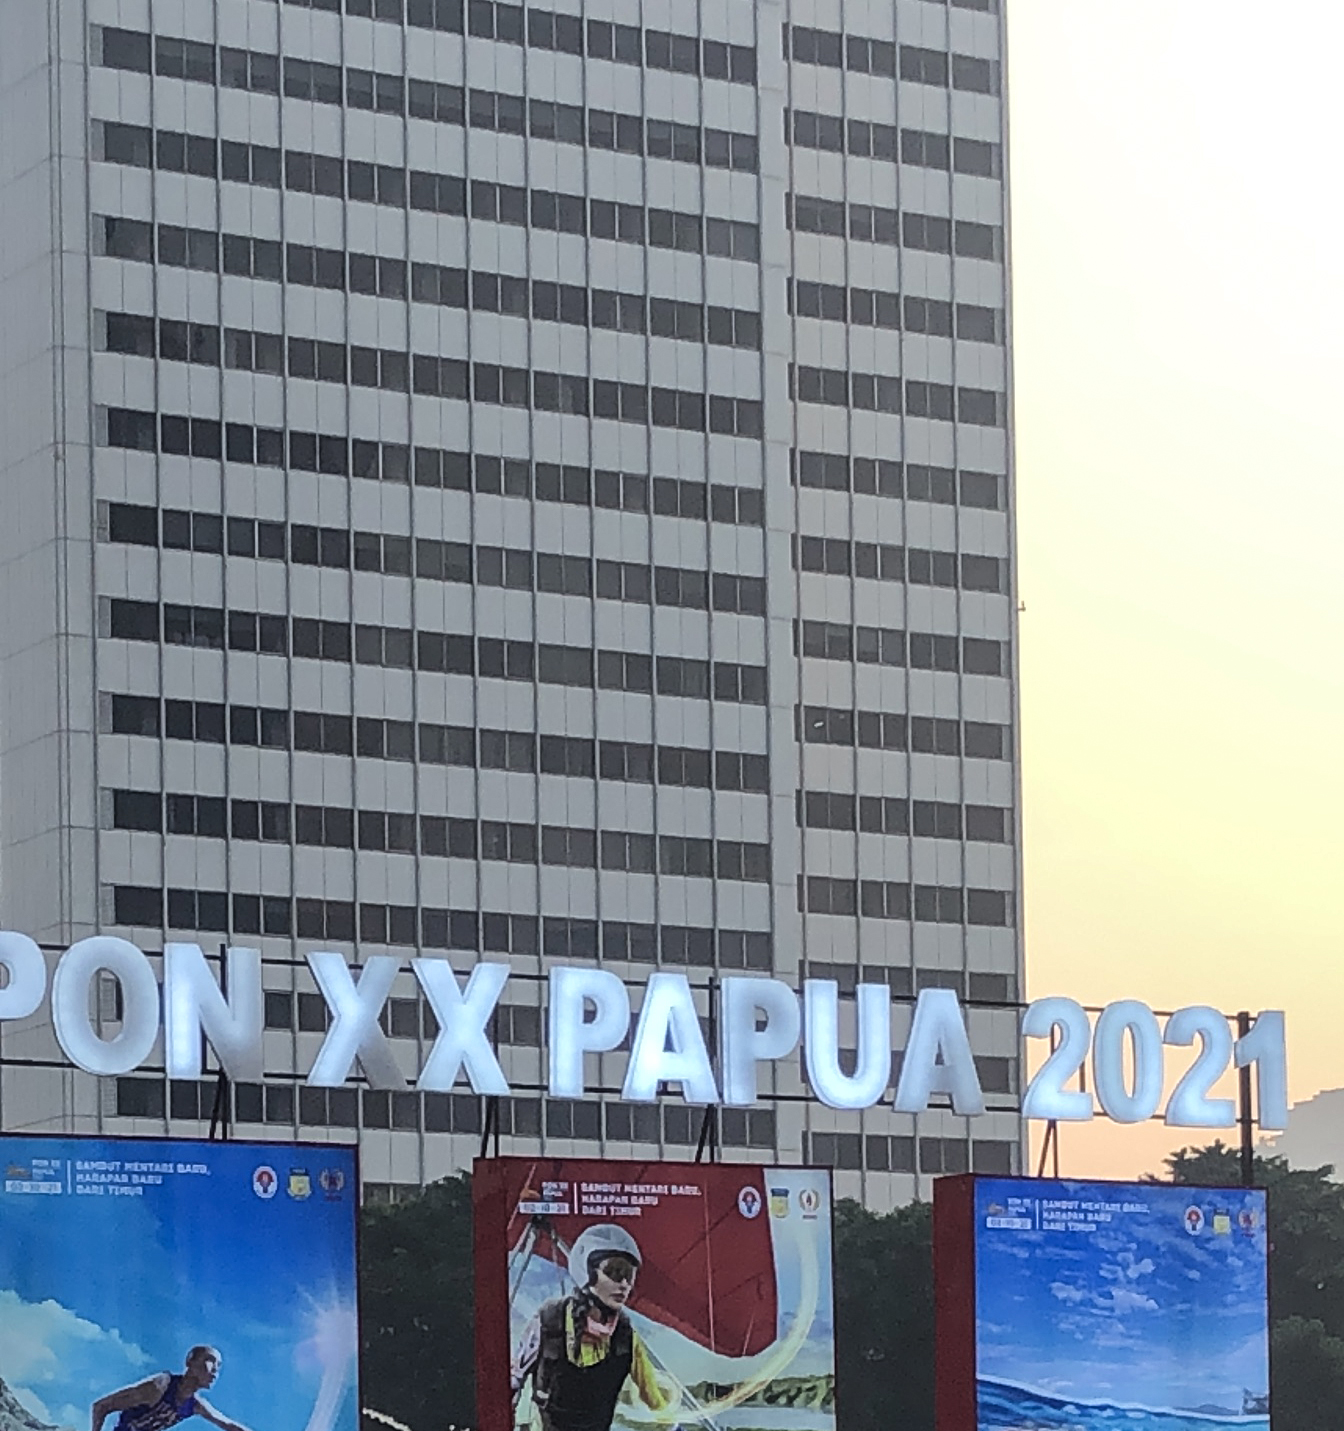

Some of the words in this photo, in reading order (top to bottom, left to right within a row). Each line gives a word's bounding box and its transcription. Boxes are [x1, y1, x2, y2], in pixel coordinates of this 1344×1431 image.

[306, 949, 513, 1097] XX
[547, 965, 985, 1117] PAPUA
[1020, 996, 1290, 1131] 2021
